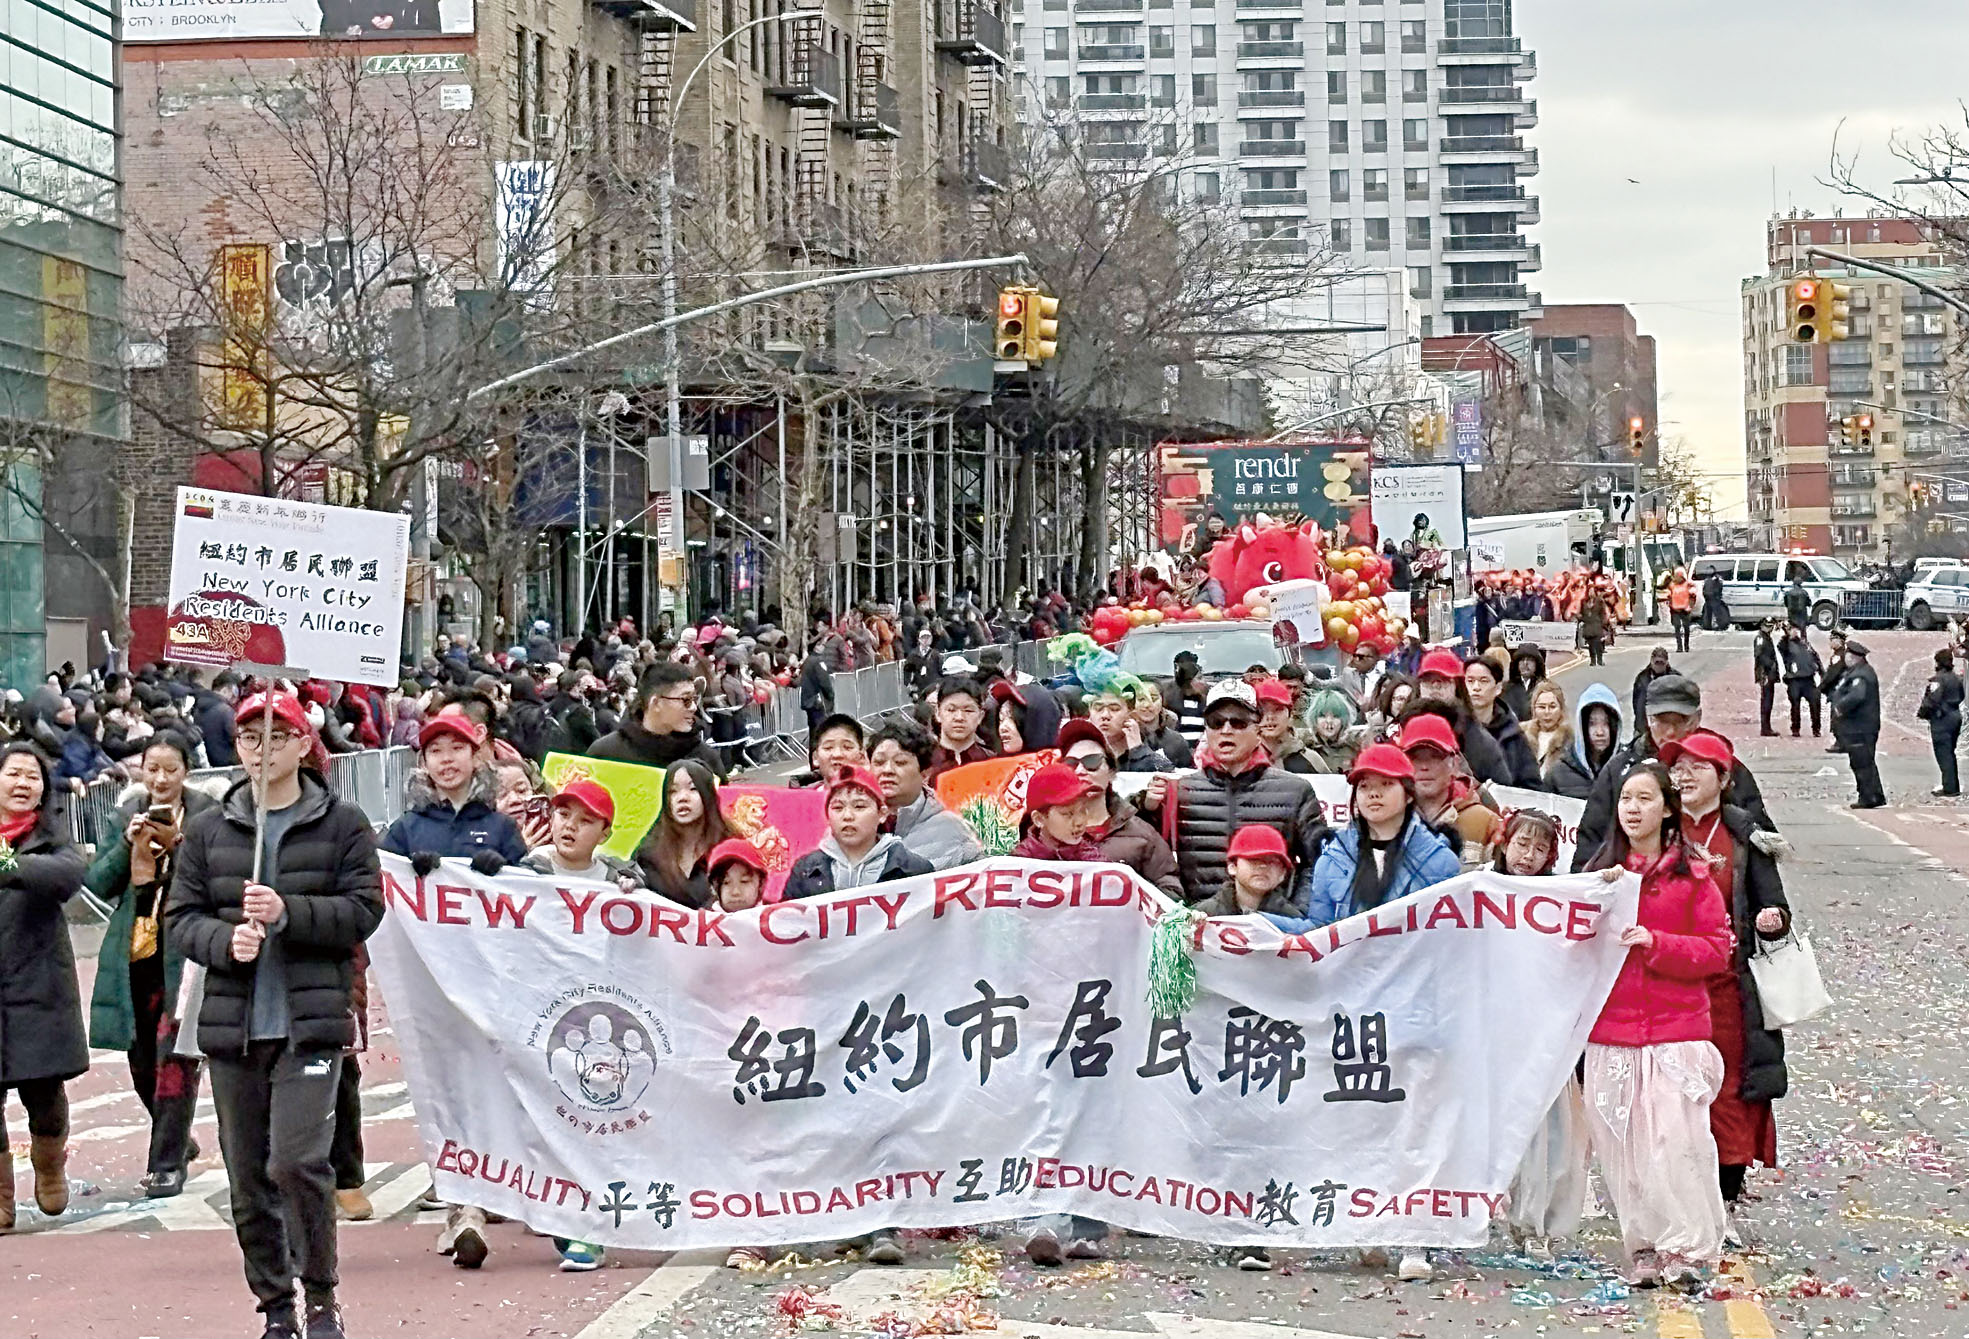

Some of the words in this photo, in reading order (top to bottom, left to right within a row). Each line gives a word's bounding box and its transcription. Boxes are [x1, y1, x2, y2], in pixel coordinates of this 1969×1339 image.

[171, 14, 237, 26] BROOKLYN
[1235, 453, 1301, 478] rendr
[1373, 475, 1400, 489] KCS
[203, 572, 249, 592] New
[262, 579, 311, 602] York
[323, 587, 372, 610] City
[176, 623, 208, 639] 43A
[184, 597, 288, 626] Residents
[299, 612, 385, 637] Alliance
[379, 870, 538, 929] NEW
[556, 887, 736, 947] YORK
[759, 891, 912, 945] CITY
[1276, 890, 1601, 963] ALLIANCE
[562, 987, 585, 1002] City
[727, 979, 1406, 1105] 紐約市居民聯盟
[436, 1139, 591, 1212] EQUALITY
[598, 1181, 681, 1230] 平等
[689, 1169, 946, 1219] SOLIDARITY
[953, 1157, 1033, 1203] 互助
[1034, 1157, 1254, 1218] EDUCATION
[1254, 1177, 1348, 1228] 教育
[1348, 1187, 1505, 1220] SAFETY
